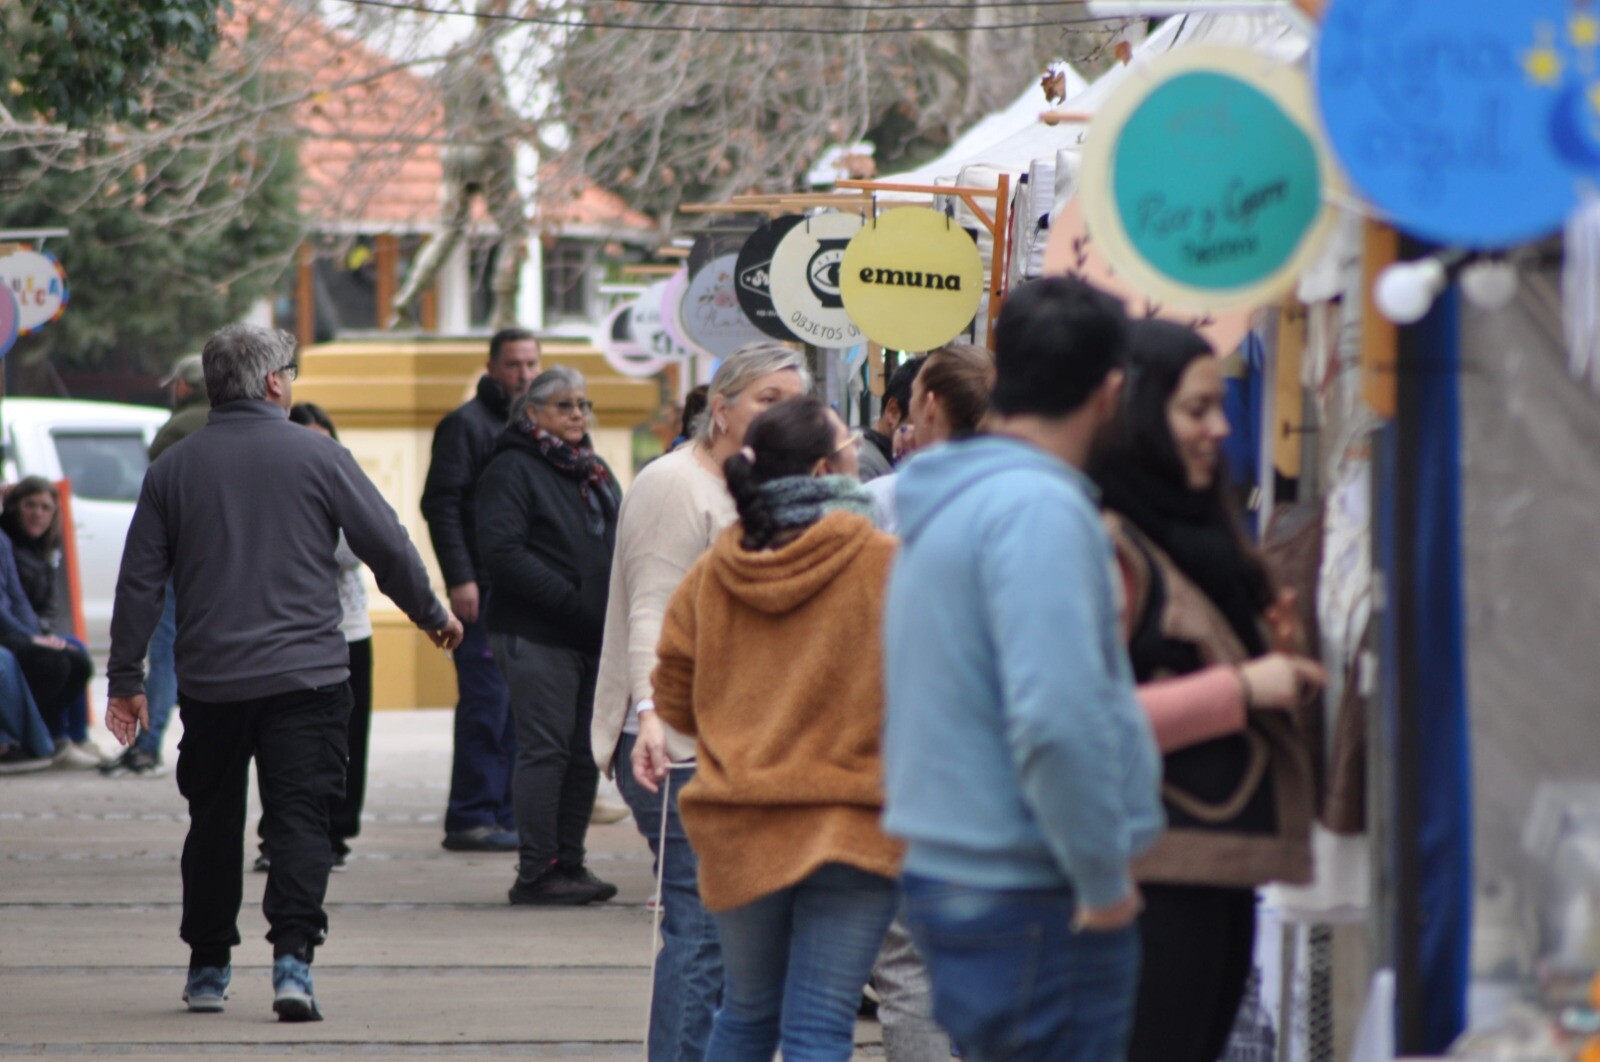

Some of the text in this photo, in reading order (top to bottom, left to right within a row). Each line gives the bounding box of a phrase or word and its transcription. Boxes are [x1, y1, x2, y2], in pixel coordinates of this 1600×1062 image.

[12, 276, 60, 306] ULECA
[859, 267, 961, 291] emuna
[791, 310, 843, 340] OBJETOS
